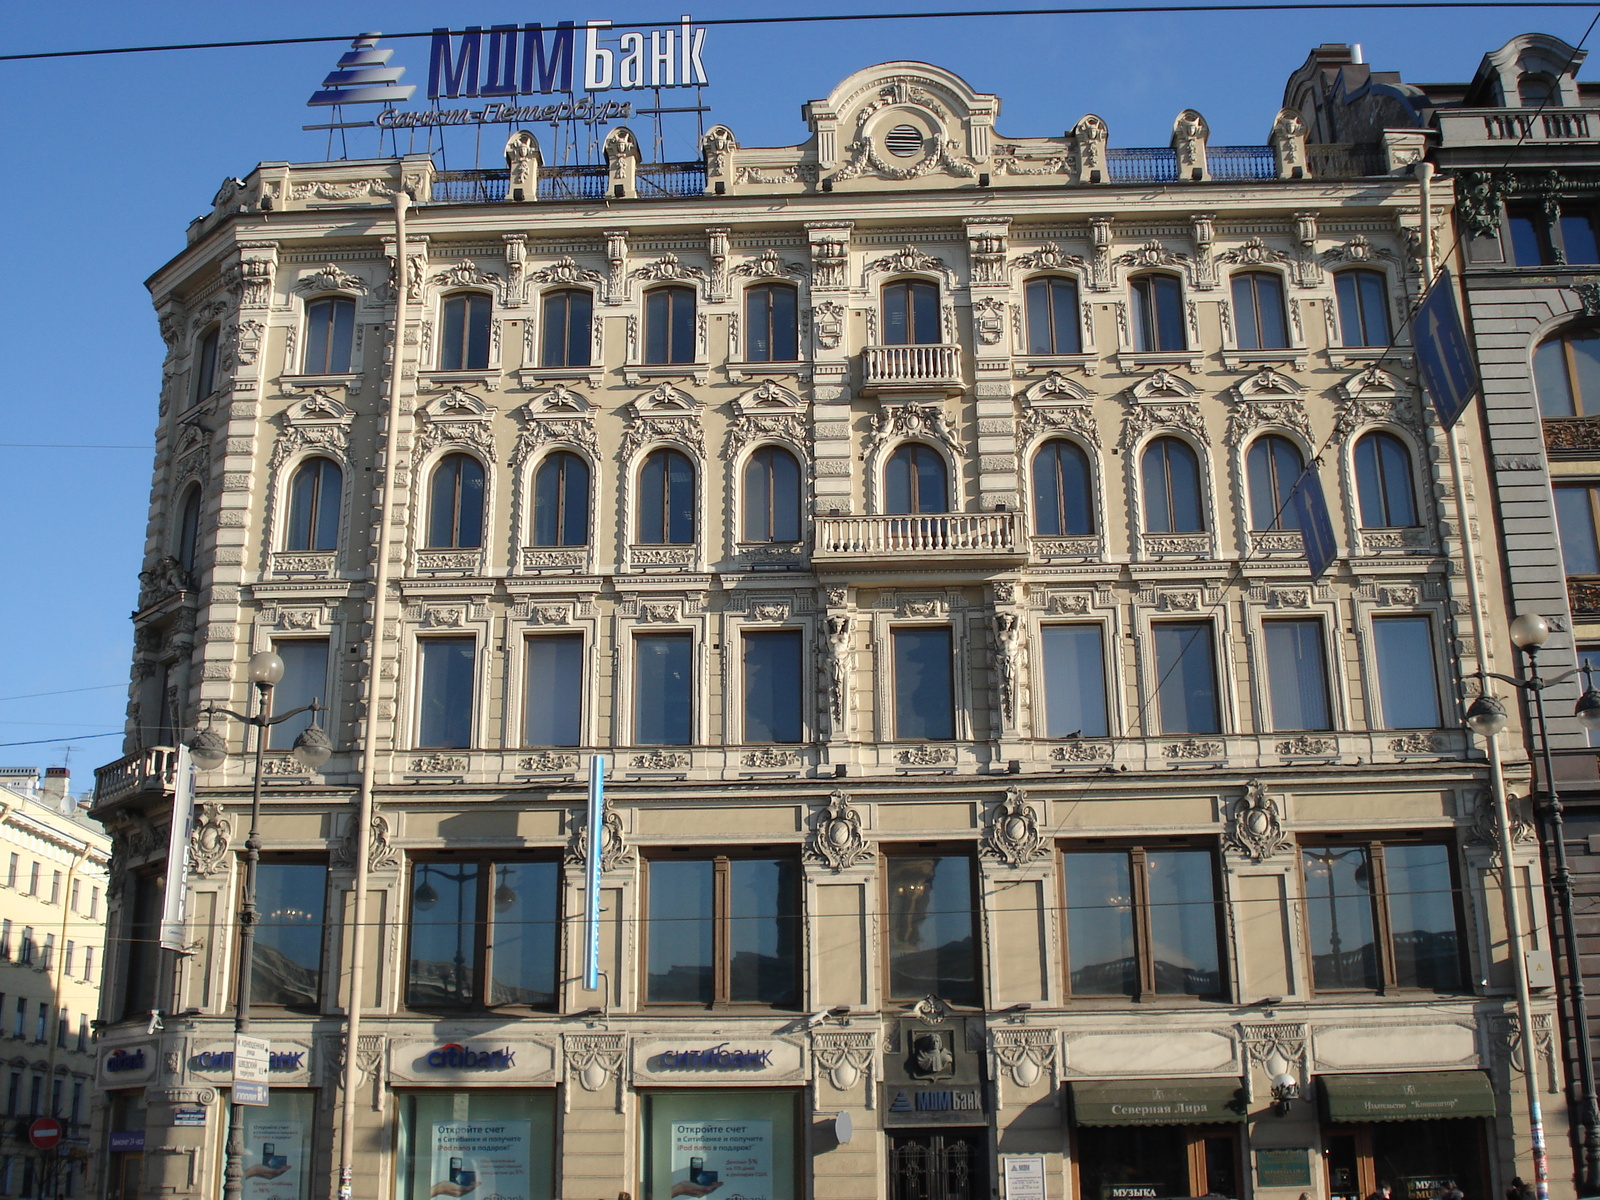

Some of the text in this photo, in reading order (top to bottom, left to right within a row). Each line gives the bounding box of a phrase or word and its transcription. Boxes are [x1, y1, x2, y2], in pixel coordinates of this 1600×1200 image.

[377, 96, 632, 128] Санкт-Петербург
[427, 1043, 516, 1068] citibank
[1111, 1102, 1209, 1117] Северная Лира
[1364, 1101, 1407, 1112] Издательство
[438, 1125, 483, 1135] Откройте
[677, 1125, 724, 1135] Откройте
[1113, 1188, 1157, 1197] МУЗЫКА
